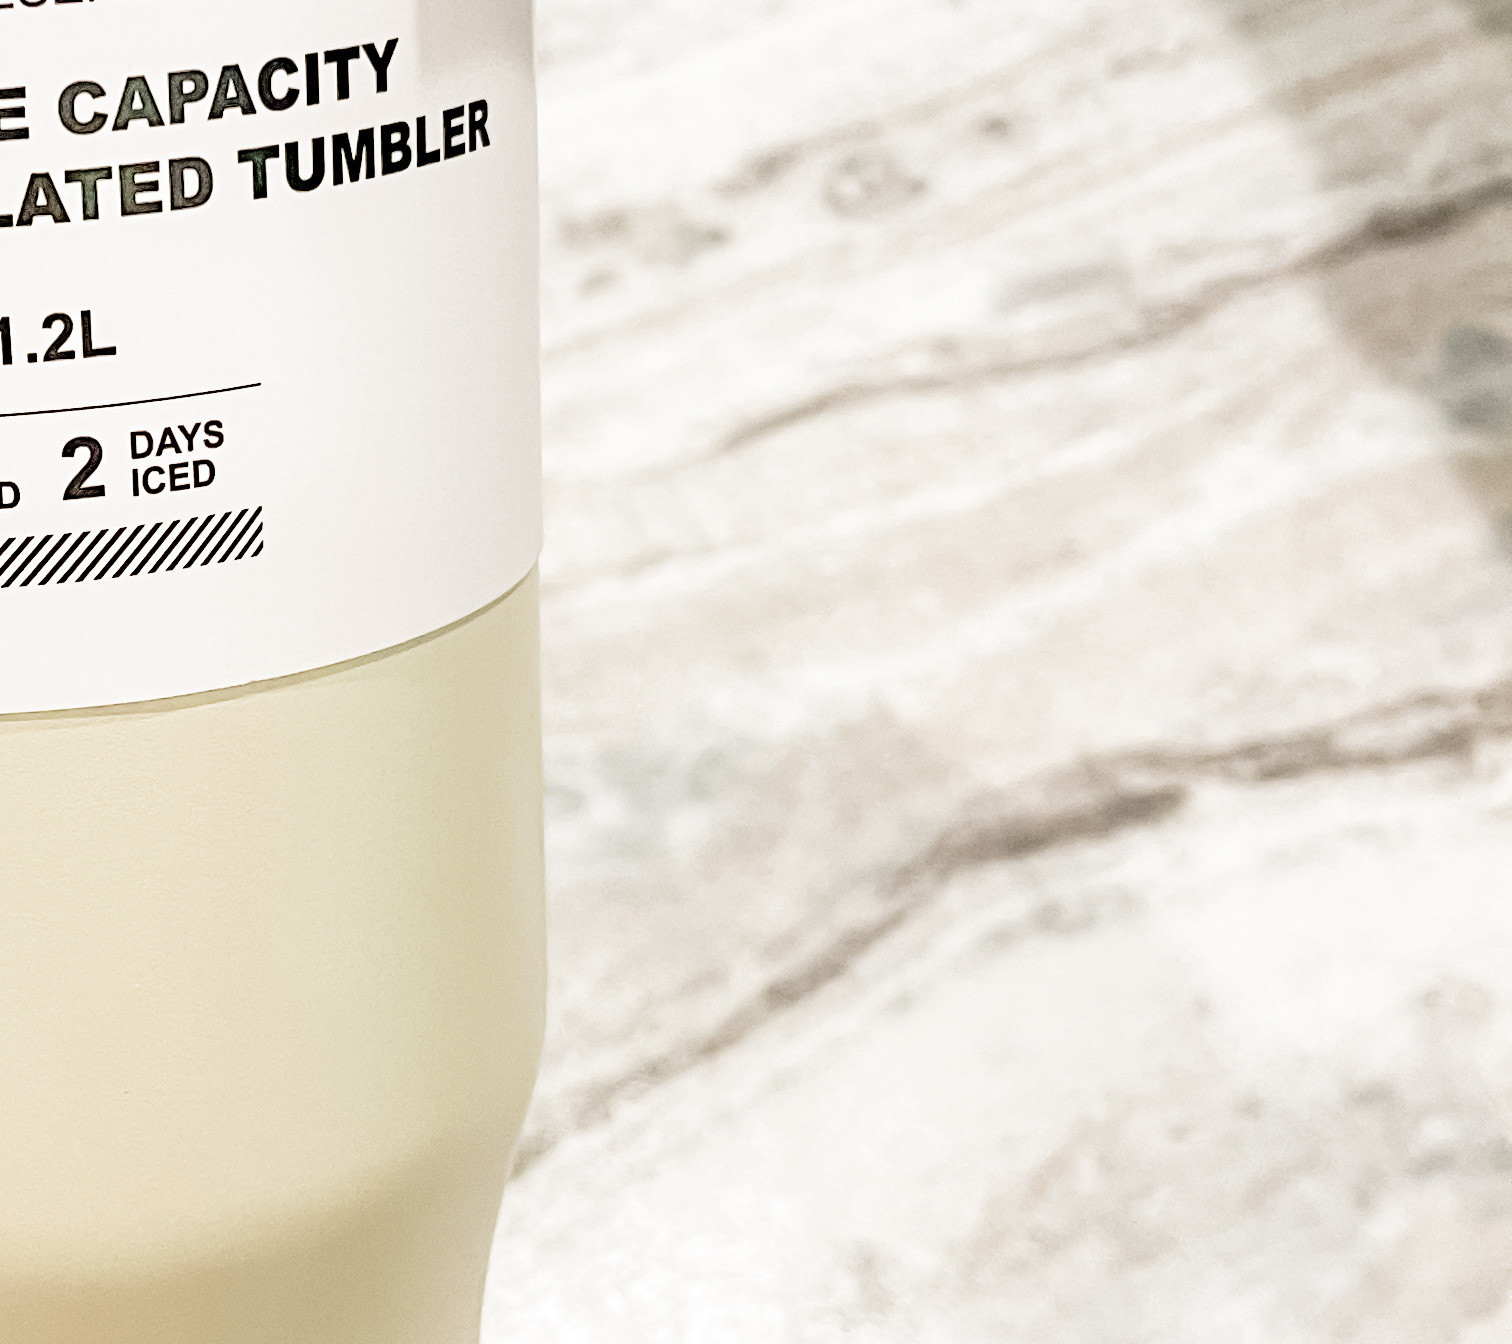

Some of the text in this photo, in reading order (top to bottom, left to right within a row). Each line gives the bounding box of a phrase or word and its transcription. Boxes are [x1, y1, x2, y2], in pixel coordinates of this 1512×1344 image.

[57, 37, 399, 136] CAPACITY
[236, 98, 491, 201] TUMBLER
[61, 435, 106, 501] 2
[130, 419, 225, 460] DAYS
[131, 459, 216, 497] ICED
